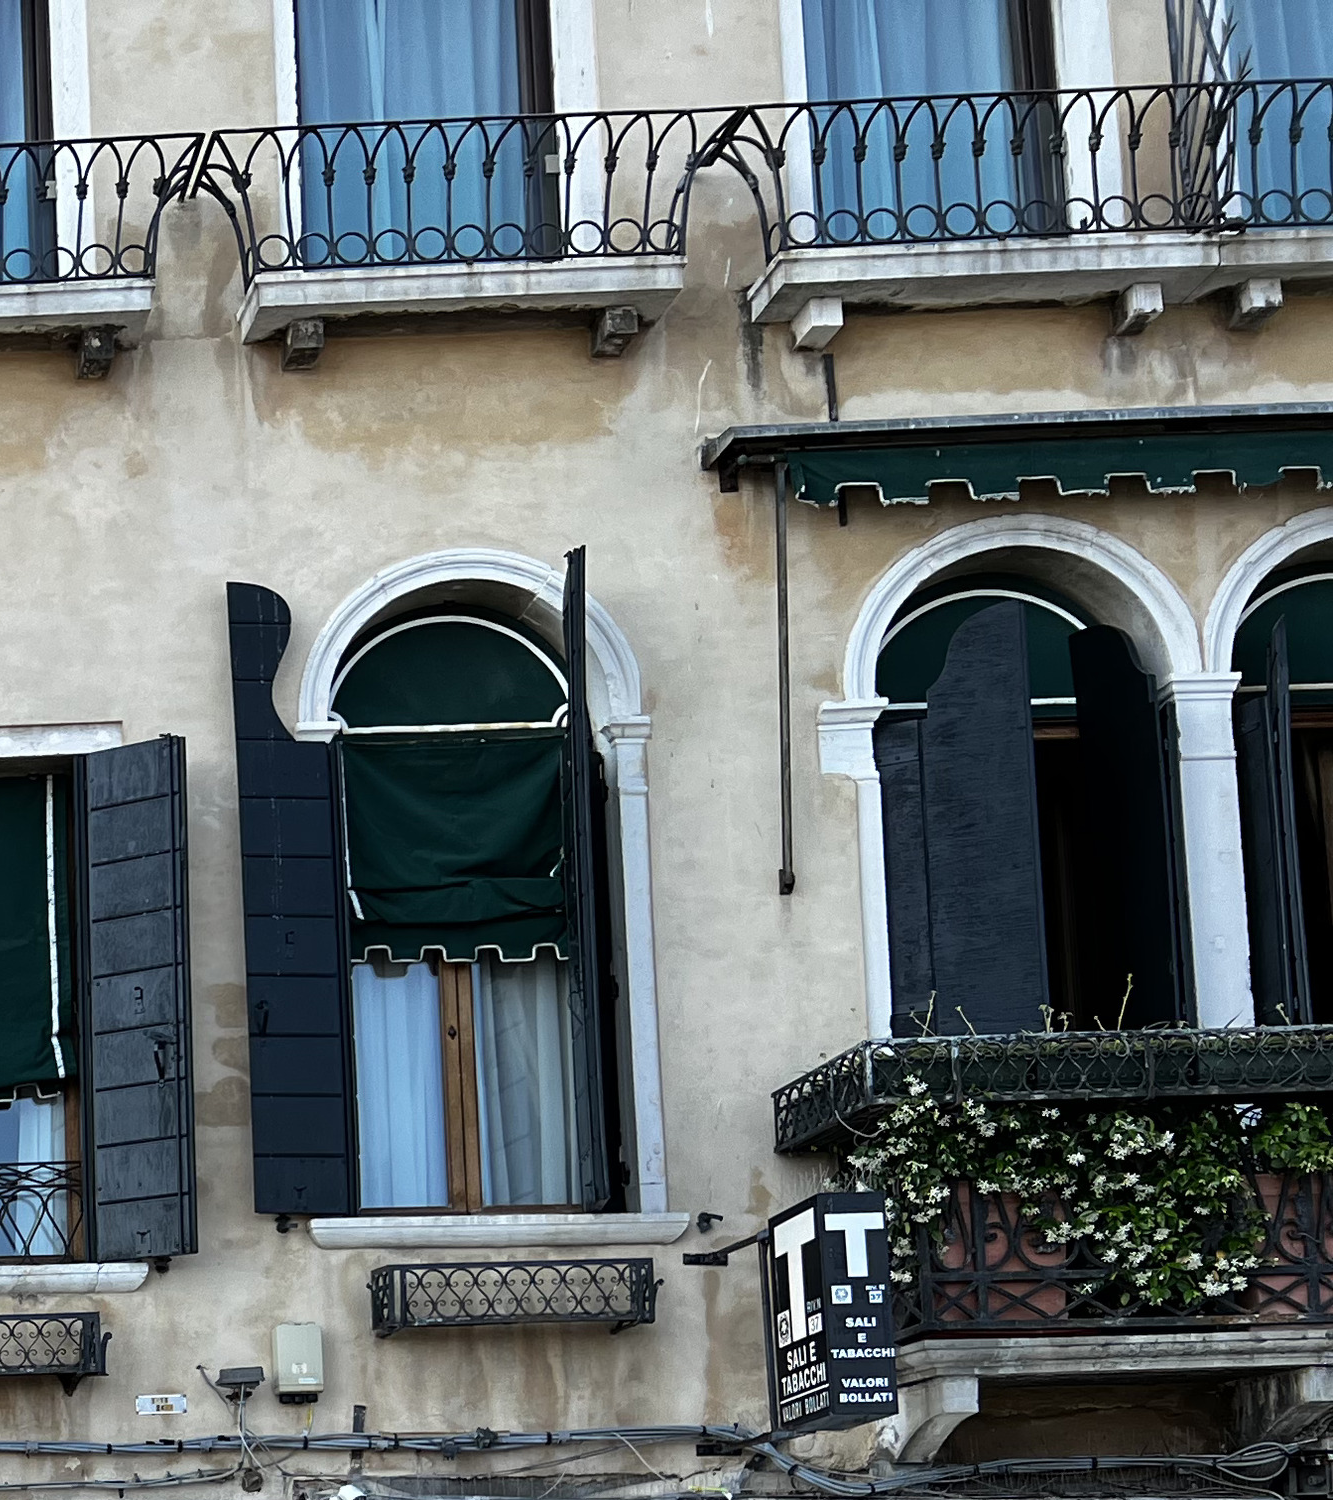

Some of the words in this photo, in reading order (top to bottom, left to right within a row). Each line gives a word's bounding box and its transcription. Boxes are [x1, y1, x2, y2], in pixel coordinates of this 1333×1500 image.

[845, 1316, 877, 1328] SALI
[857, 1332, 867, 1343] E
[786, 1344, 808, 1371] SALI
[809, 1341, 817, 1362] E
[831, 1348, 896, 1359] TABACCHI
[781, 1362, 826, 1397] TABACCHI
[841, 1378, 889, 1388] VALORI
[839, 1392, 894, 1403] BOLLATI
[783, 1401, 803, 1423] VALORI
[805, 1391, 830, 1416] BOLLATI
